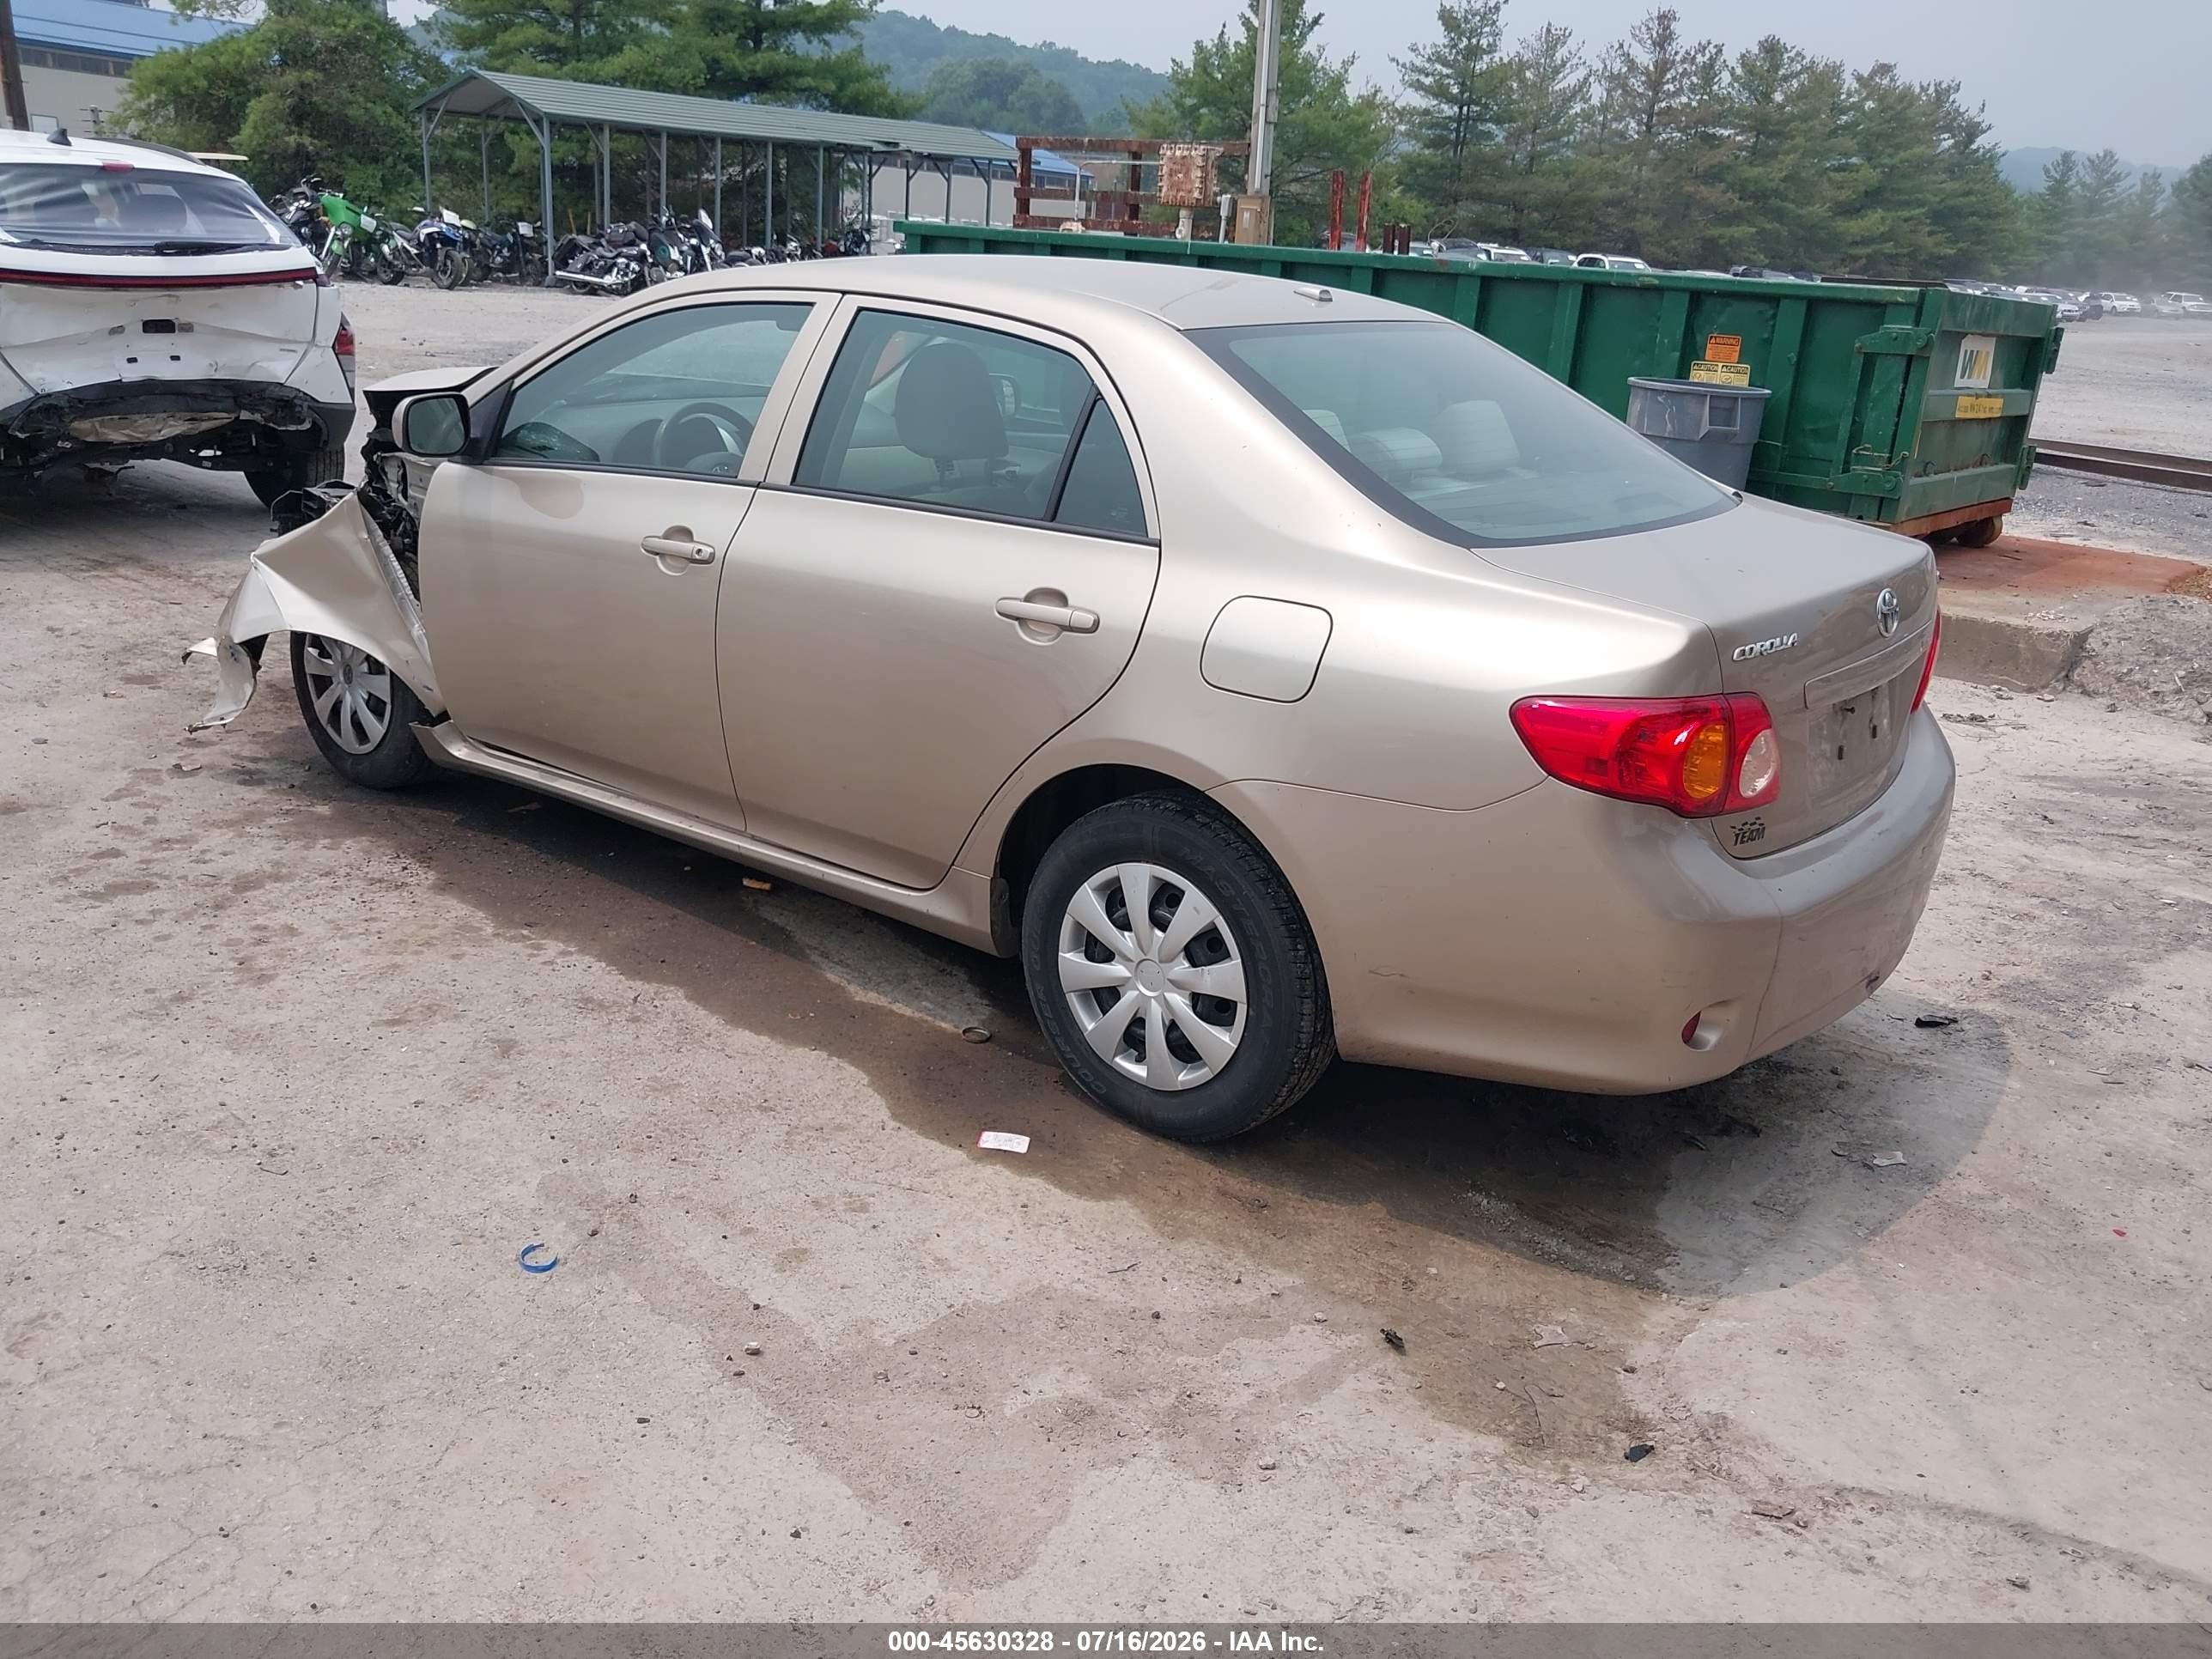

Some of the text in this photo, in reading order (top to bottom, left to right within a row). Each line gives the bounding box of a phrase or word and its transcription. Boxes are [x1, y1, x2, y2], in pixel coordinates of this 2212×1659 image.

[1716, 336, 1739, 345] WARNING
[1960, 349, 1990, 380] WM
[1733, 632, 1797, 661] COROLLA
[1734, 826, 1765, 846] TEAM
